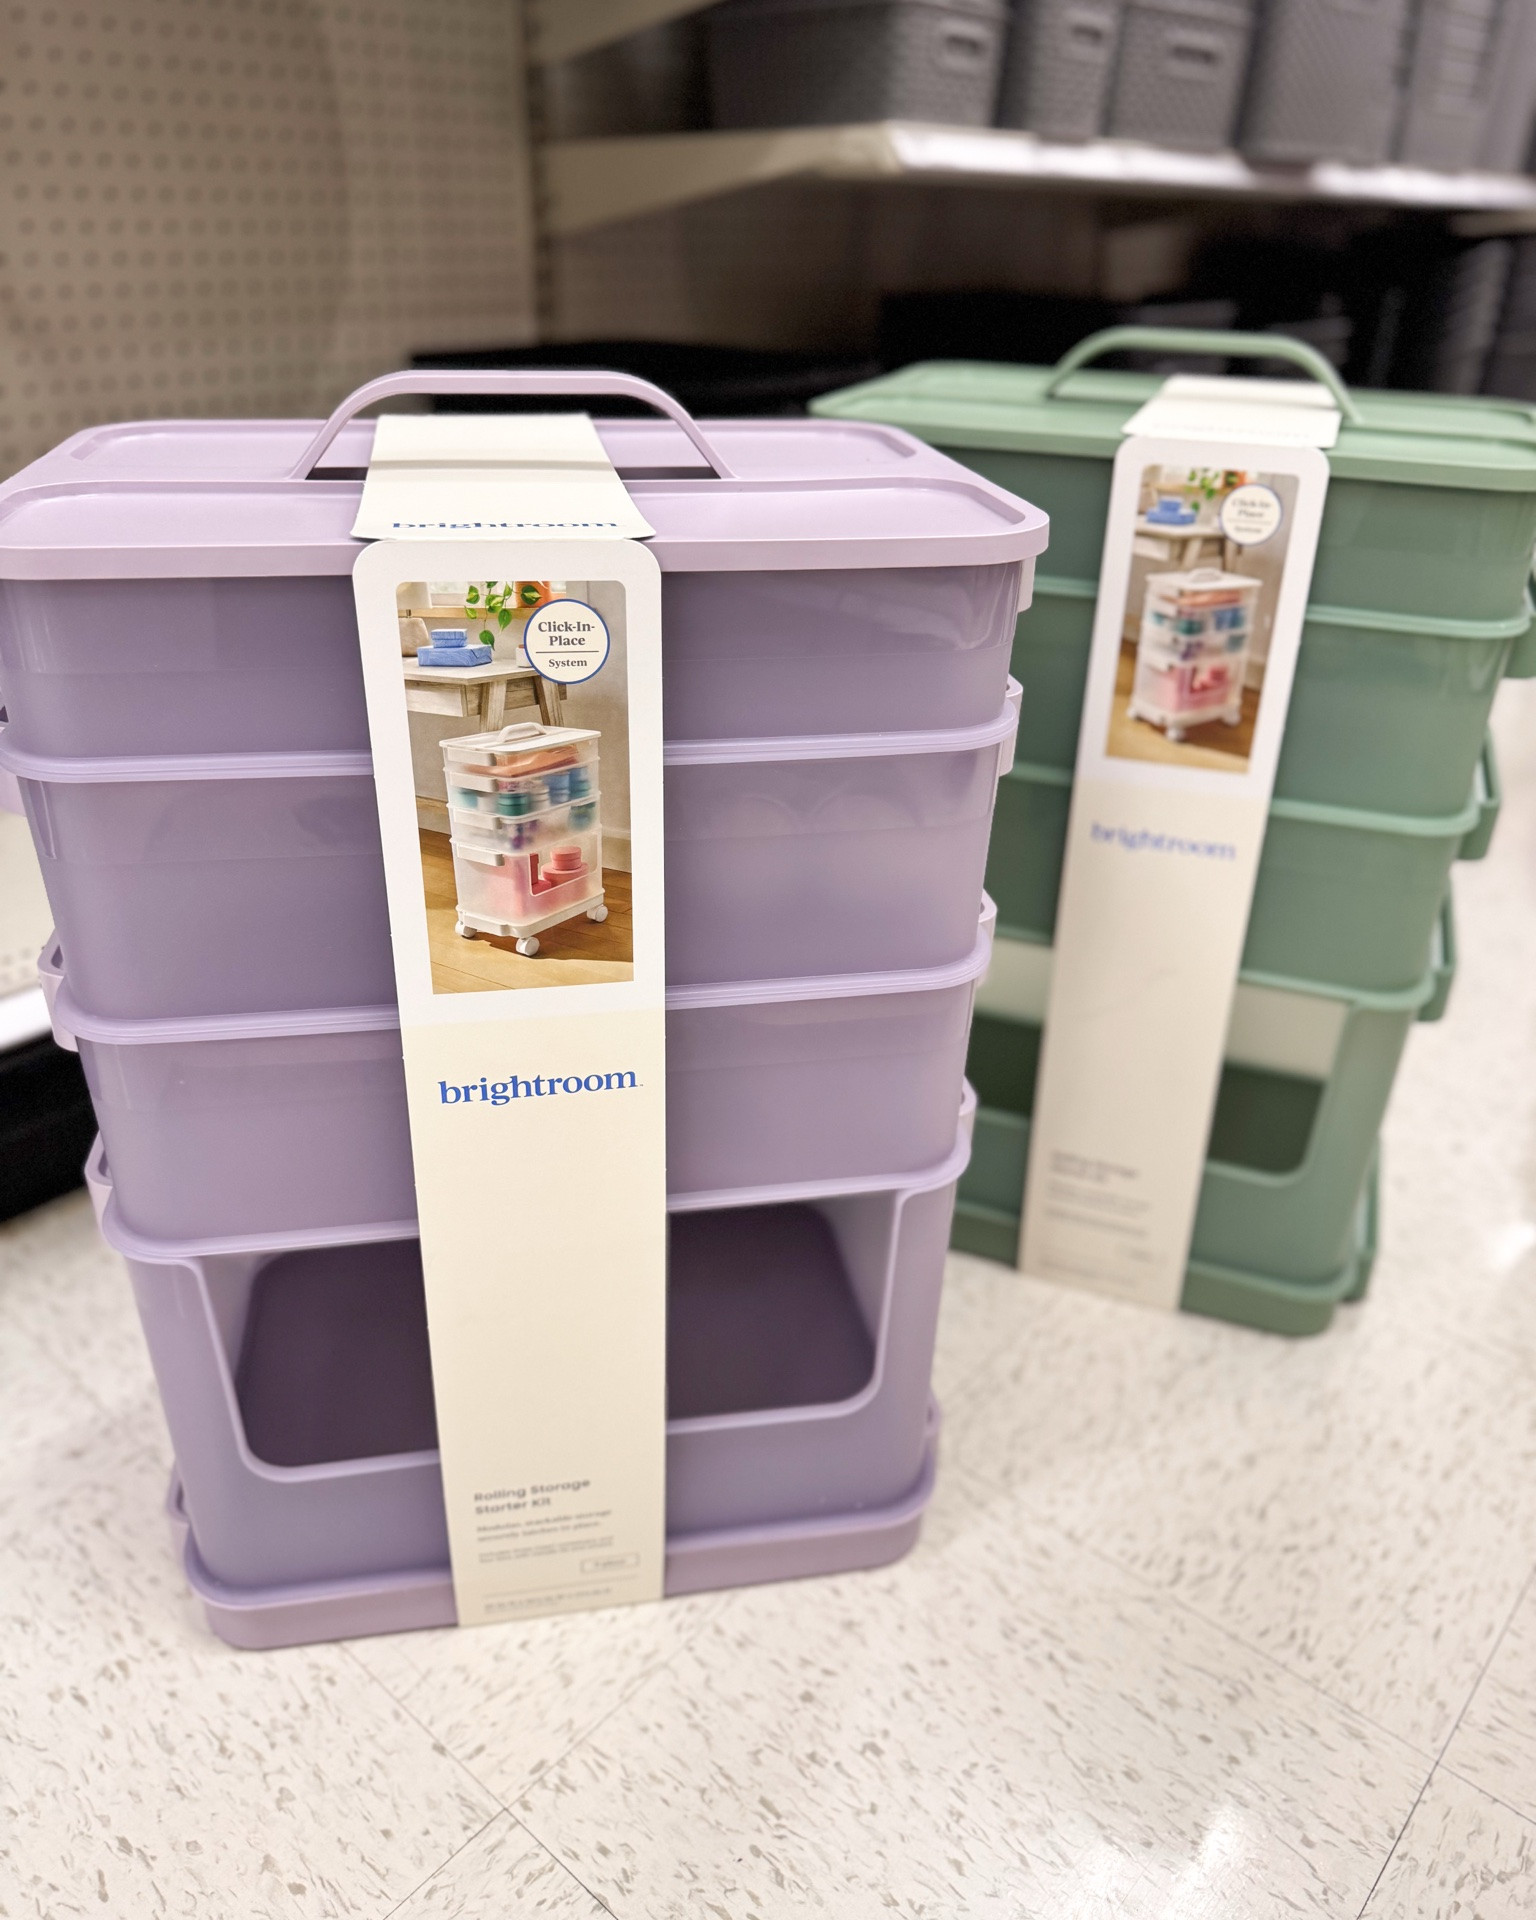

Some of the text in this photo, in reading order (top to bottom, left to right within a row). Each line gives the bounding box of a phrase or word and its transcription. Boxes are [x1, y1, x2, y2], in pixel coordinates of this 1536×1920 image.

[537, 621, 595, 633] Click-In-
[549, 635, 586, 646] Place
[548, 658, 587, 669] System
[437, 1070, 639, 1106] brightroom
[474, 1479, 590, 1501] Rolling Storage
[475, 1498, 551, 1515] Starter Kit
